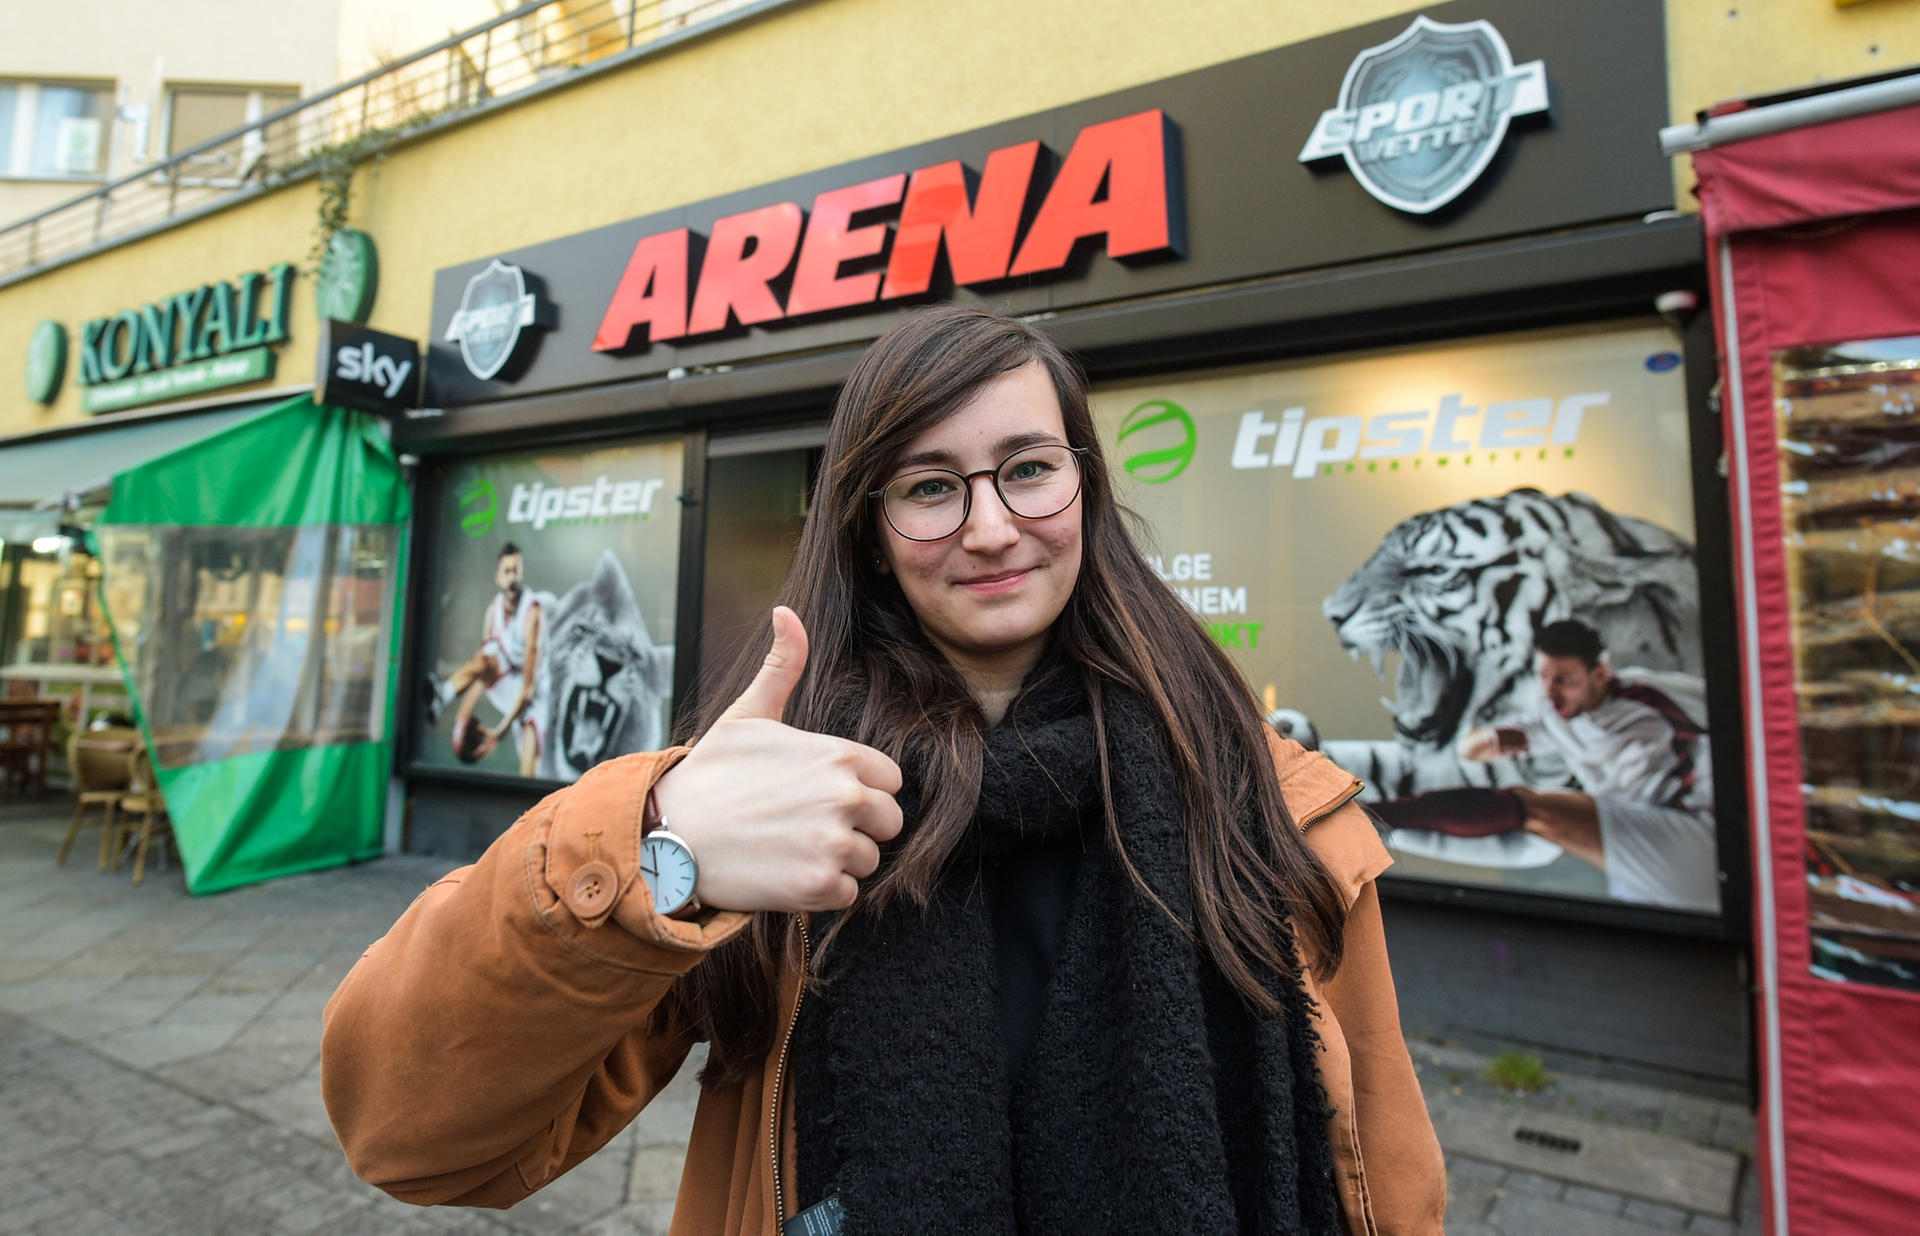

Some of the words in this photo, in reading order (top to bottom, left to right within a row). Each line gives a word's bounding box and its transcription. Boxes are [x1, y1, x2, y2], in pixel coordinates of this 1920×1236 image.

[1319, 70, 1536, 151] SPORT
[591, 108, 1172, 352] ARENA
[77, 263, 292, 386] KONYALI
[336, 341, 413, 399] sky
[1231, 391, 1611, 479] tipster
[506, 475, 665, 531] tipster
[1144, 552, 1213, 582] LGE
[1172, 585, 1248, 615] NEM
